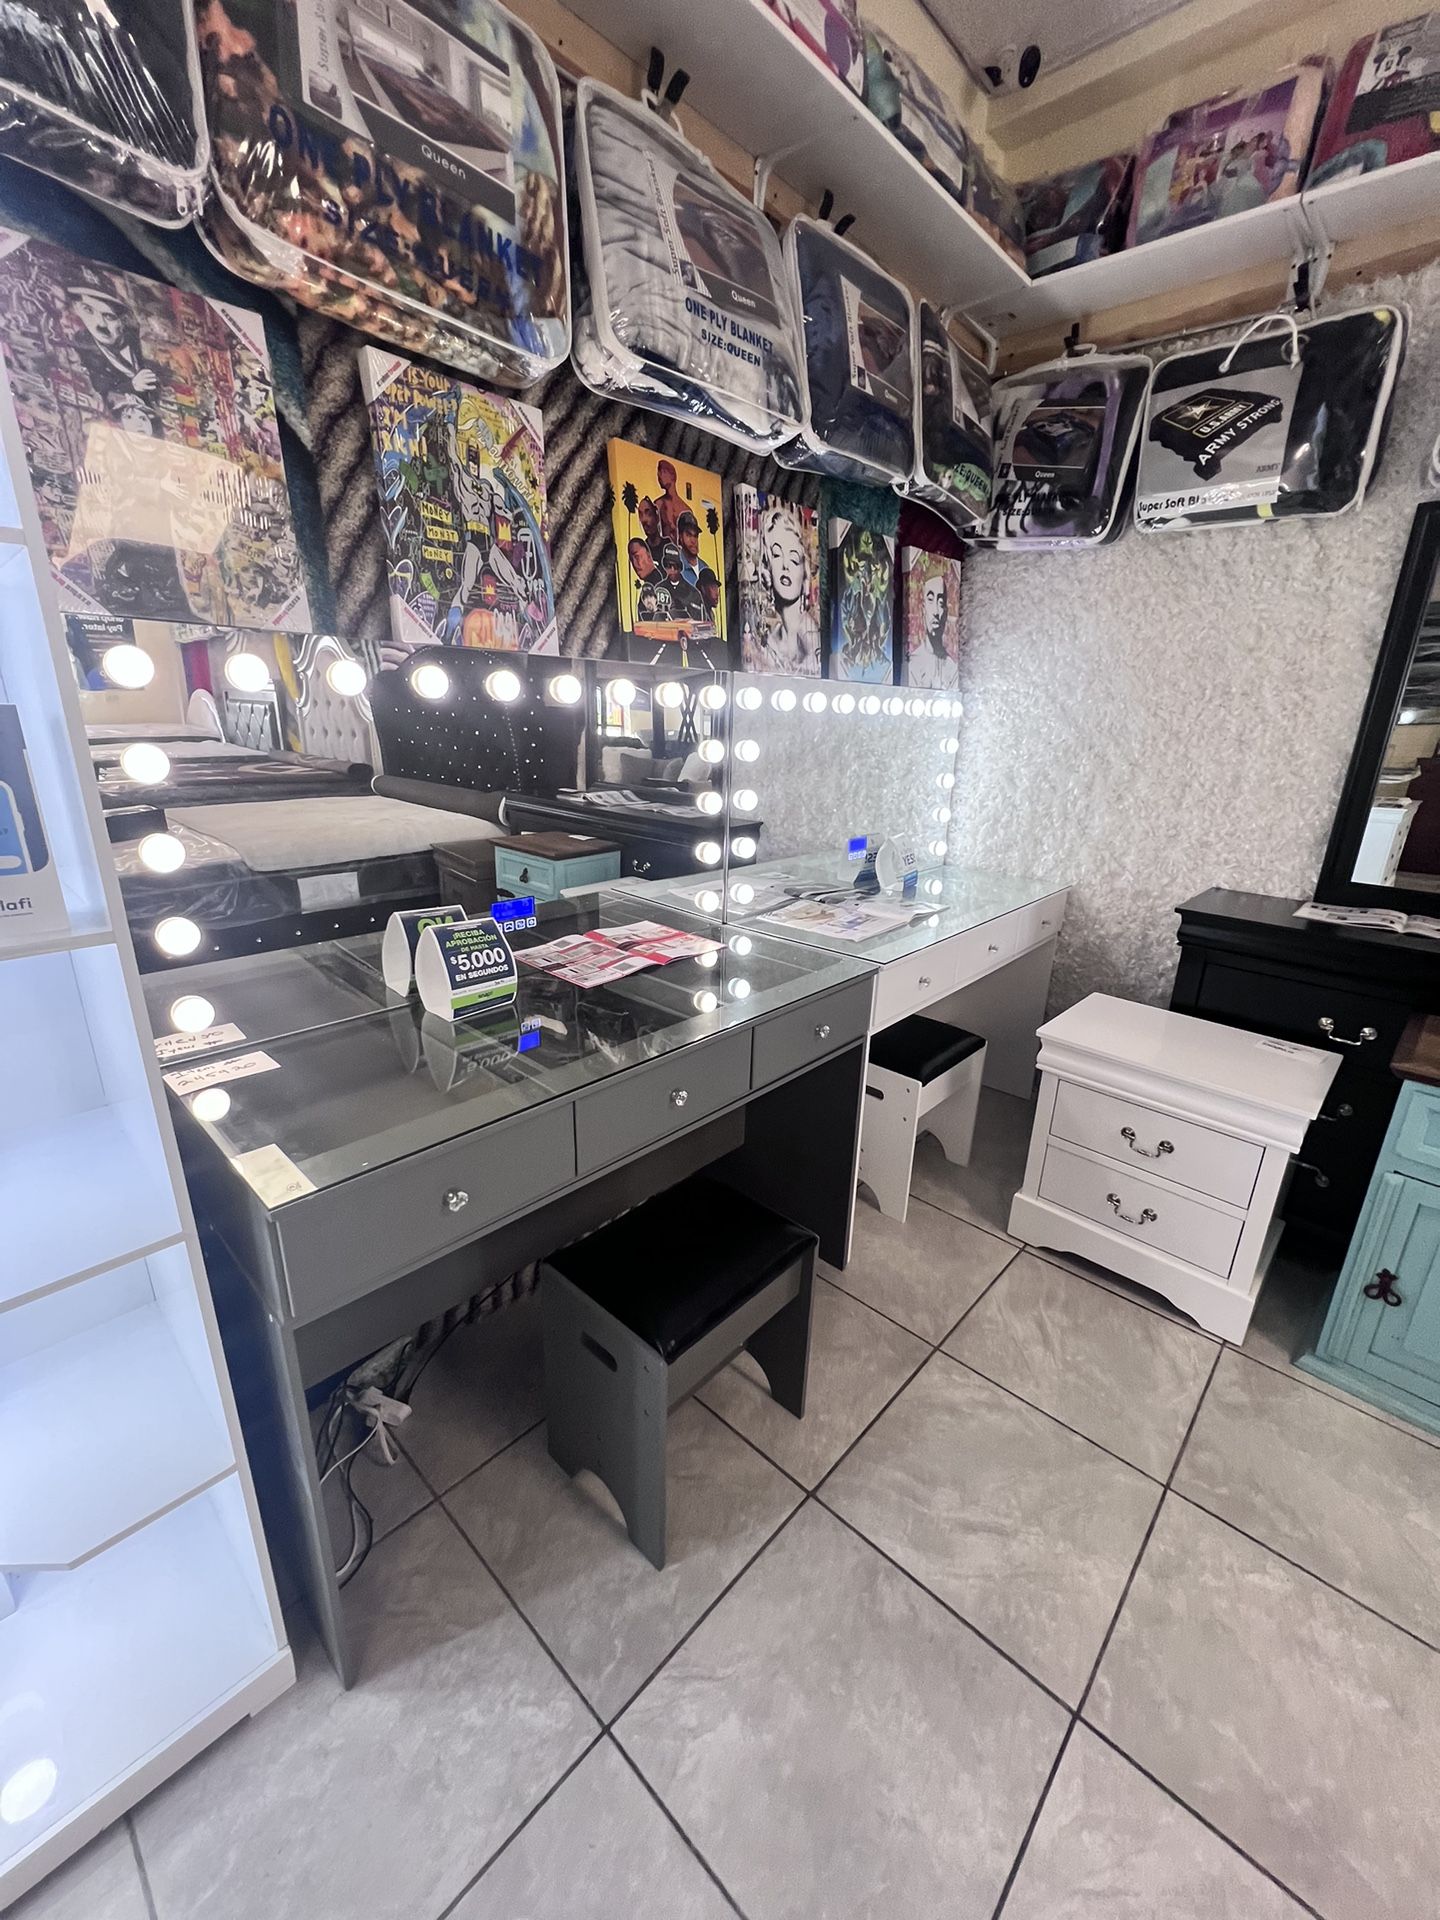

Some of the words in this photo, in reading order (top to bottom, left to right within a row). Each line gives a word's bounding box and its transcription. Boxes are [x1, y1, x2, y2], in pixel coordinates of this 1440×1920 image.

[421, 143, 467, 181] Queen
[685, 296, 707, 321] ONE
[709, 308, 728, 332] PLY
[730, 319, 774, 355] BLANKET
[701, 328, 761, 367] SIZE:QUEEN
[1198, 427, 1237, 466] ARMY
[1034, 470, 1056, 479] Queen
[1138, 501, 1163, 513] Super
[1164, 497, 1185, 509] Soft
[445, 934, 498, 949] APROBACIÓN
[450, 947, 507, 971] $5,000
[455, 973, 467, 982] EN
[467, 964, 509, 980] SEGUNDOS
